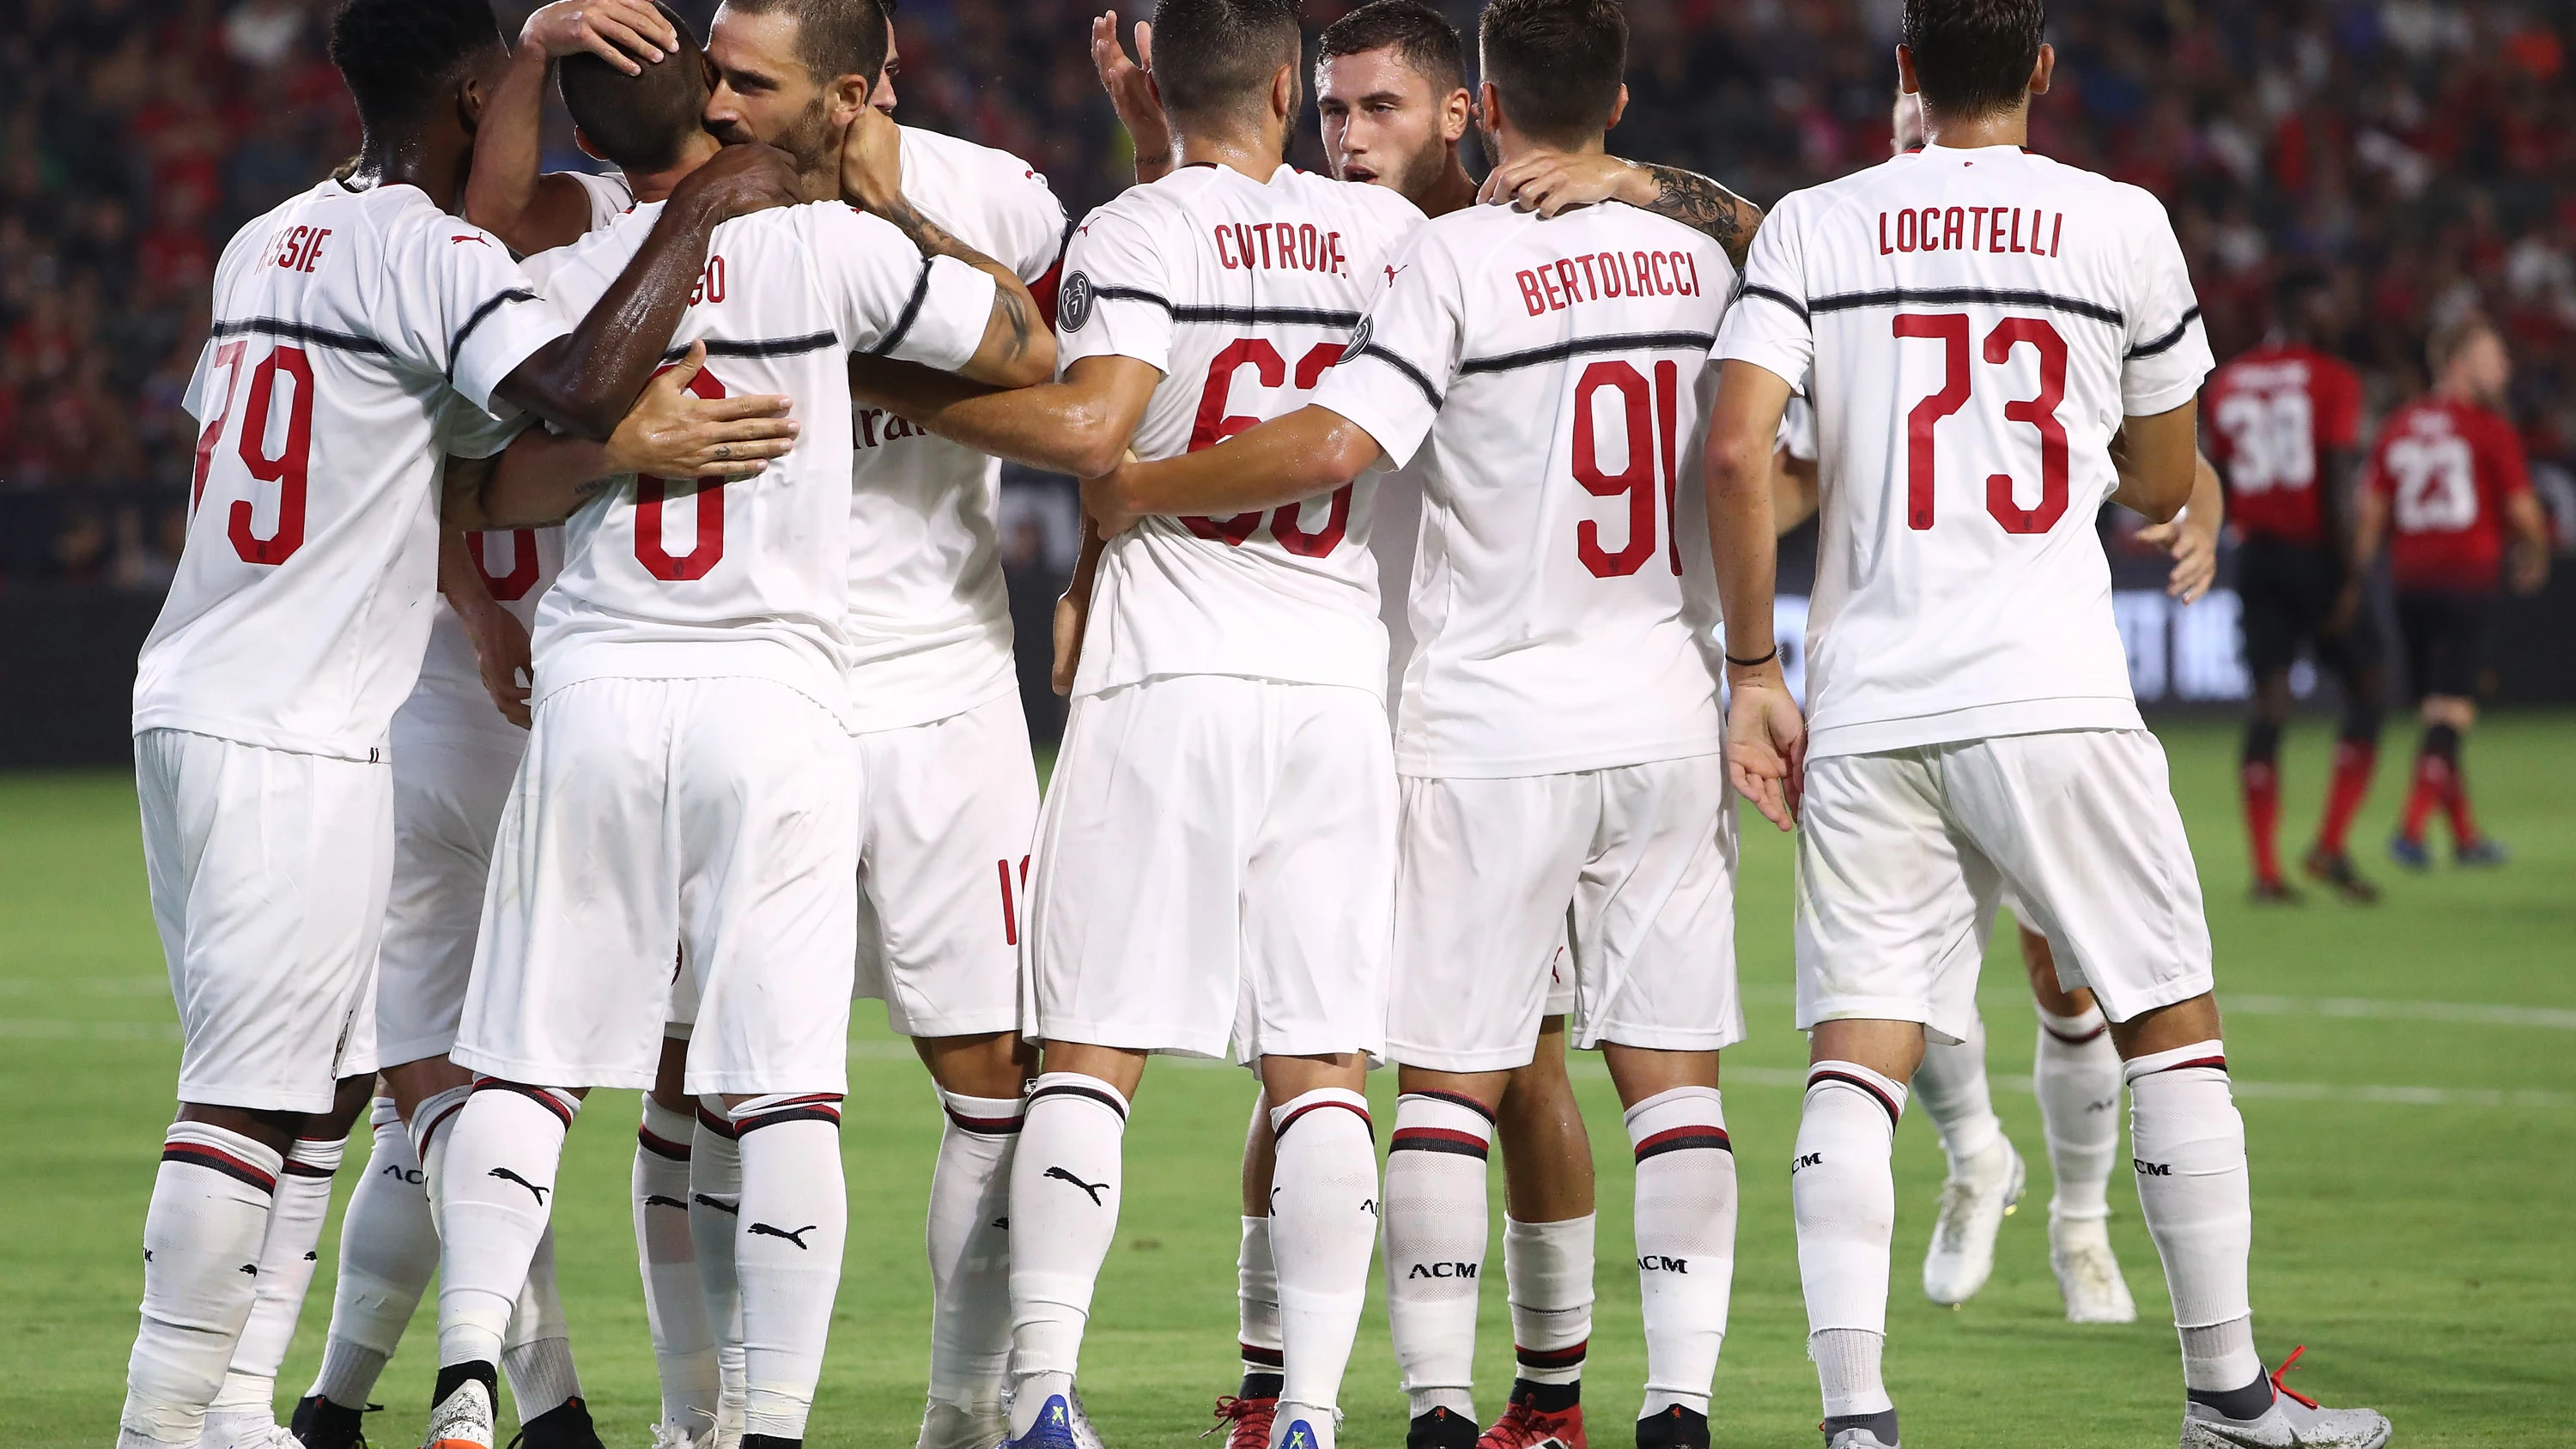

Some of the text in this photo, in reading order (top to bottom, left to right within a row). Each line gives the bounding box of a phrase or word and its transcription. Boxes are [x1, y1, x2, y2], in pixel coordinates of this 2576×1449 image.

[1880, 206, 2063, 258] LOCATELLI
[1516, 250, 1700, 317] BERTOLACCI
[194, 340, 314, 566] 79
[1571, 360, 1683, 579] 91
[1893, 313, 2069, 535] 73
[2387, 435, 2477, 533] 23
[998, 854, 1030, 946] 1
[1408, 1262, 1478, 1280] ACM
